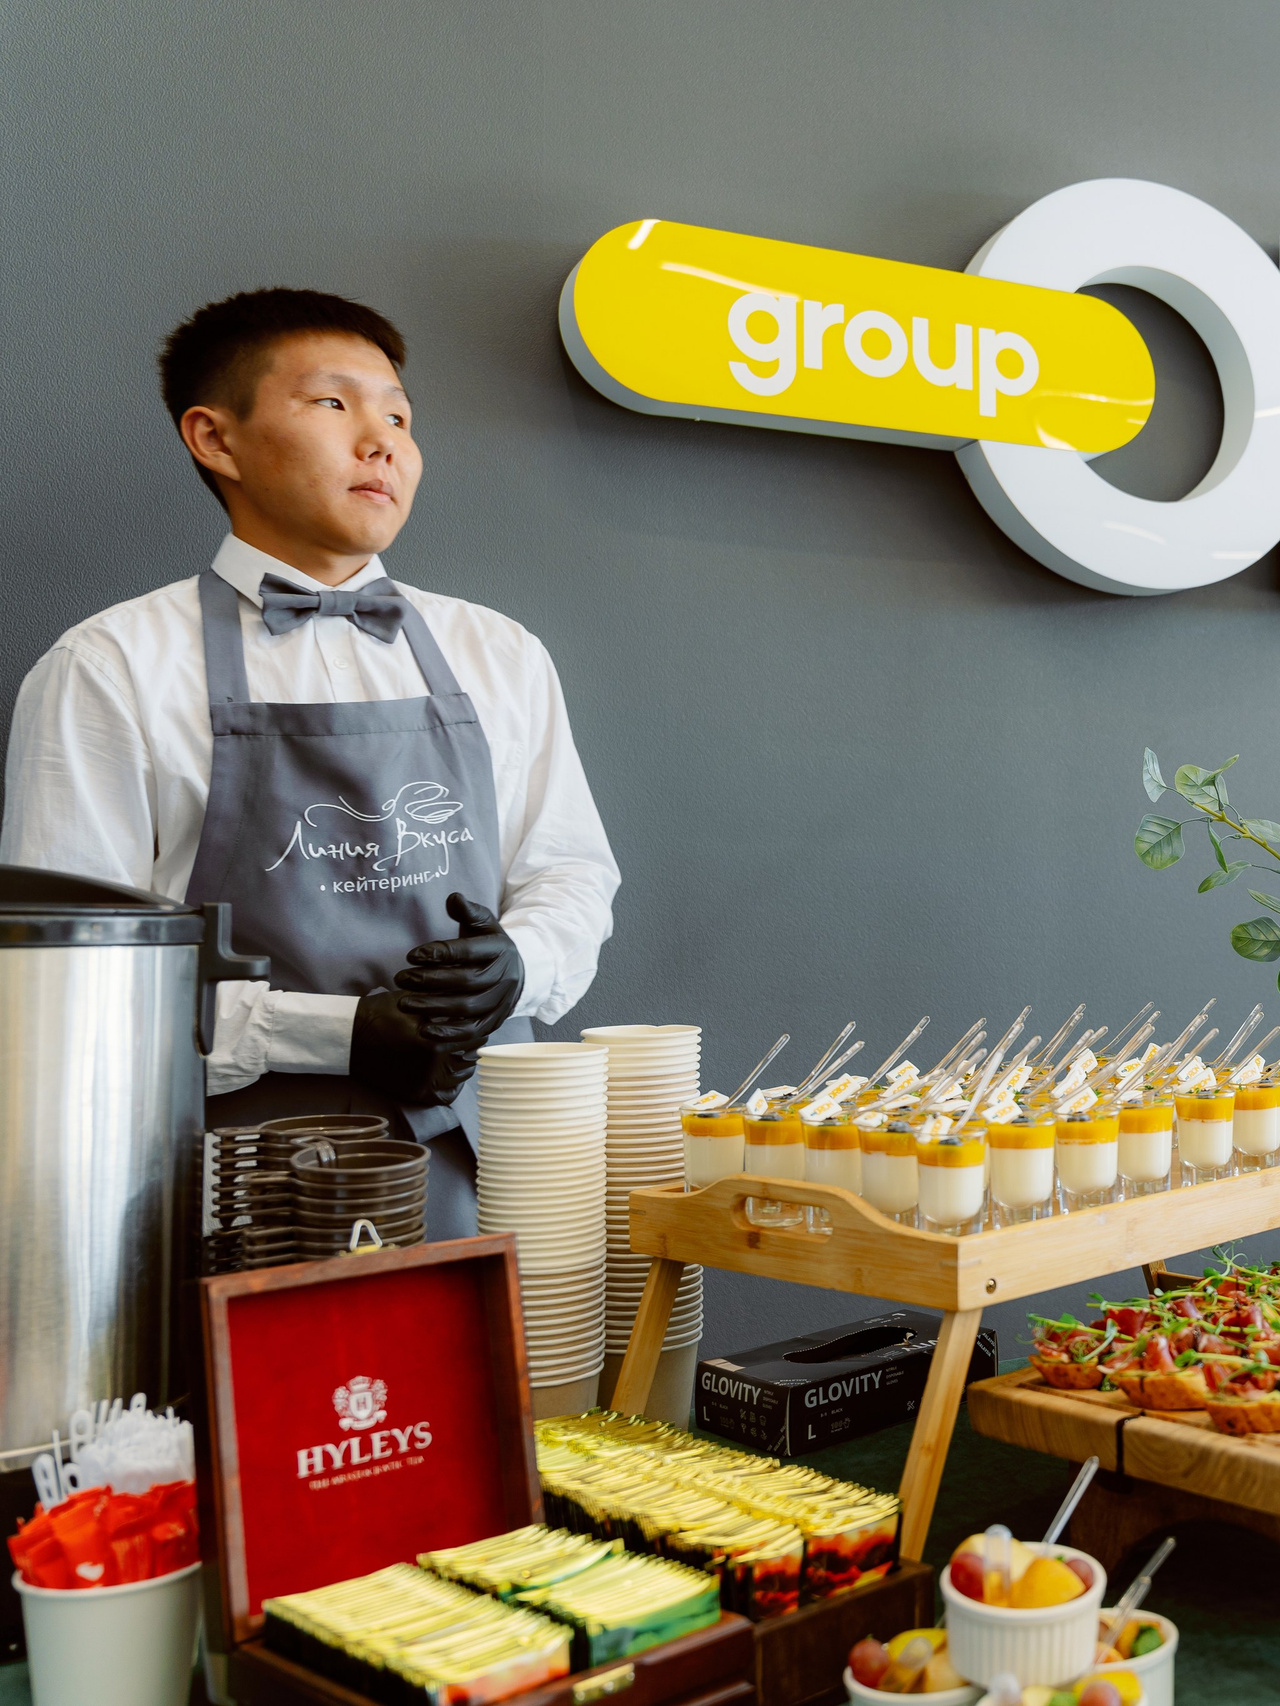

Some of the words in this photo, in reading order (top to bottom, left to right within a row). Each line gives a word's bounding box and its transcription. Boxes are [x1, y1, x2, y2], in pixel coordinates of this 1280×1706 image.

[725, 289, 1041, 417] group
[265, 820, 380, 872] Линия
[372, 817, 474, 876] Вкуса
[332, 870, 432, 893] кейтеринг
[701, 1371, 761, 1405] GLOVITY
[804, 1370, 882, 1408] GLOVITY
[703, 1405, 711, 1422] L
[807, 1423, 817, 1440] L
[297, 1421, 433, 1480] HYLEYS
